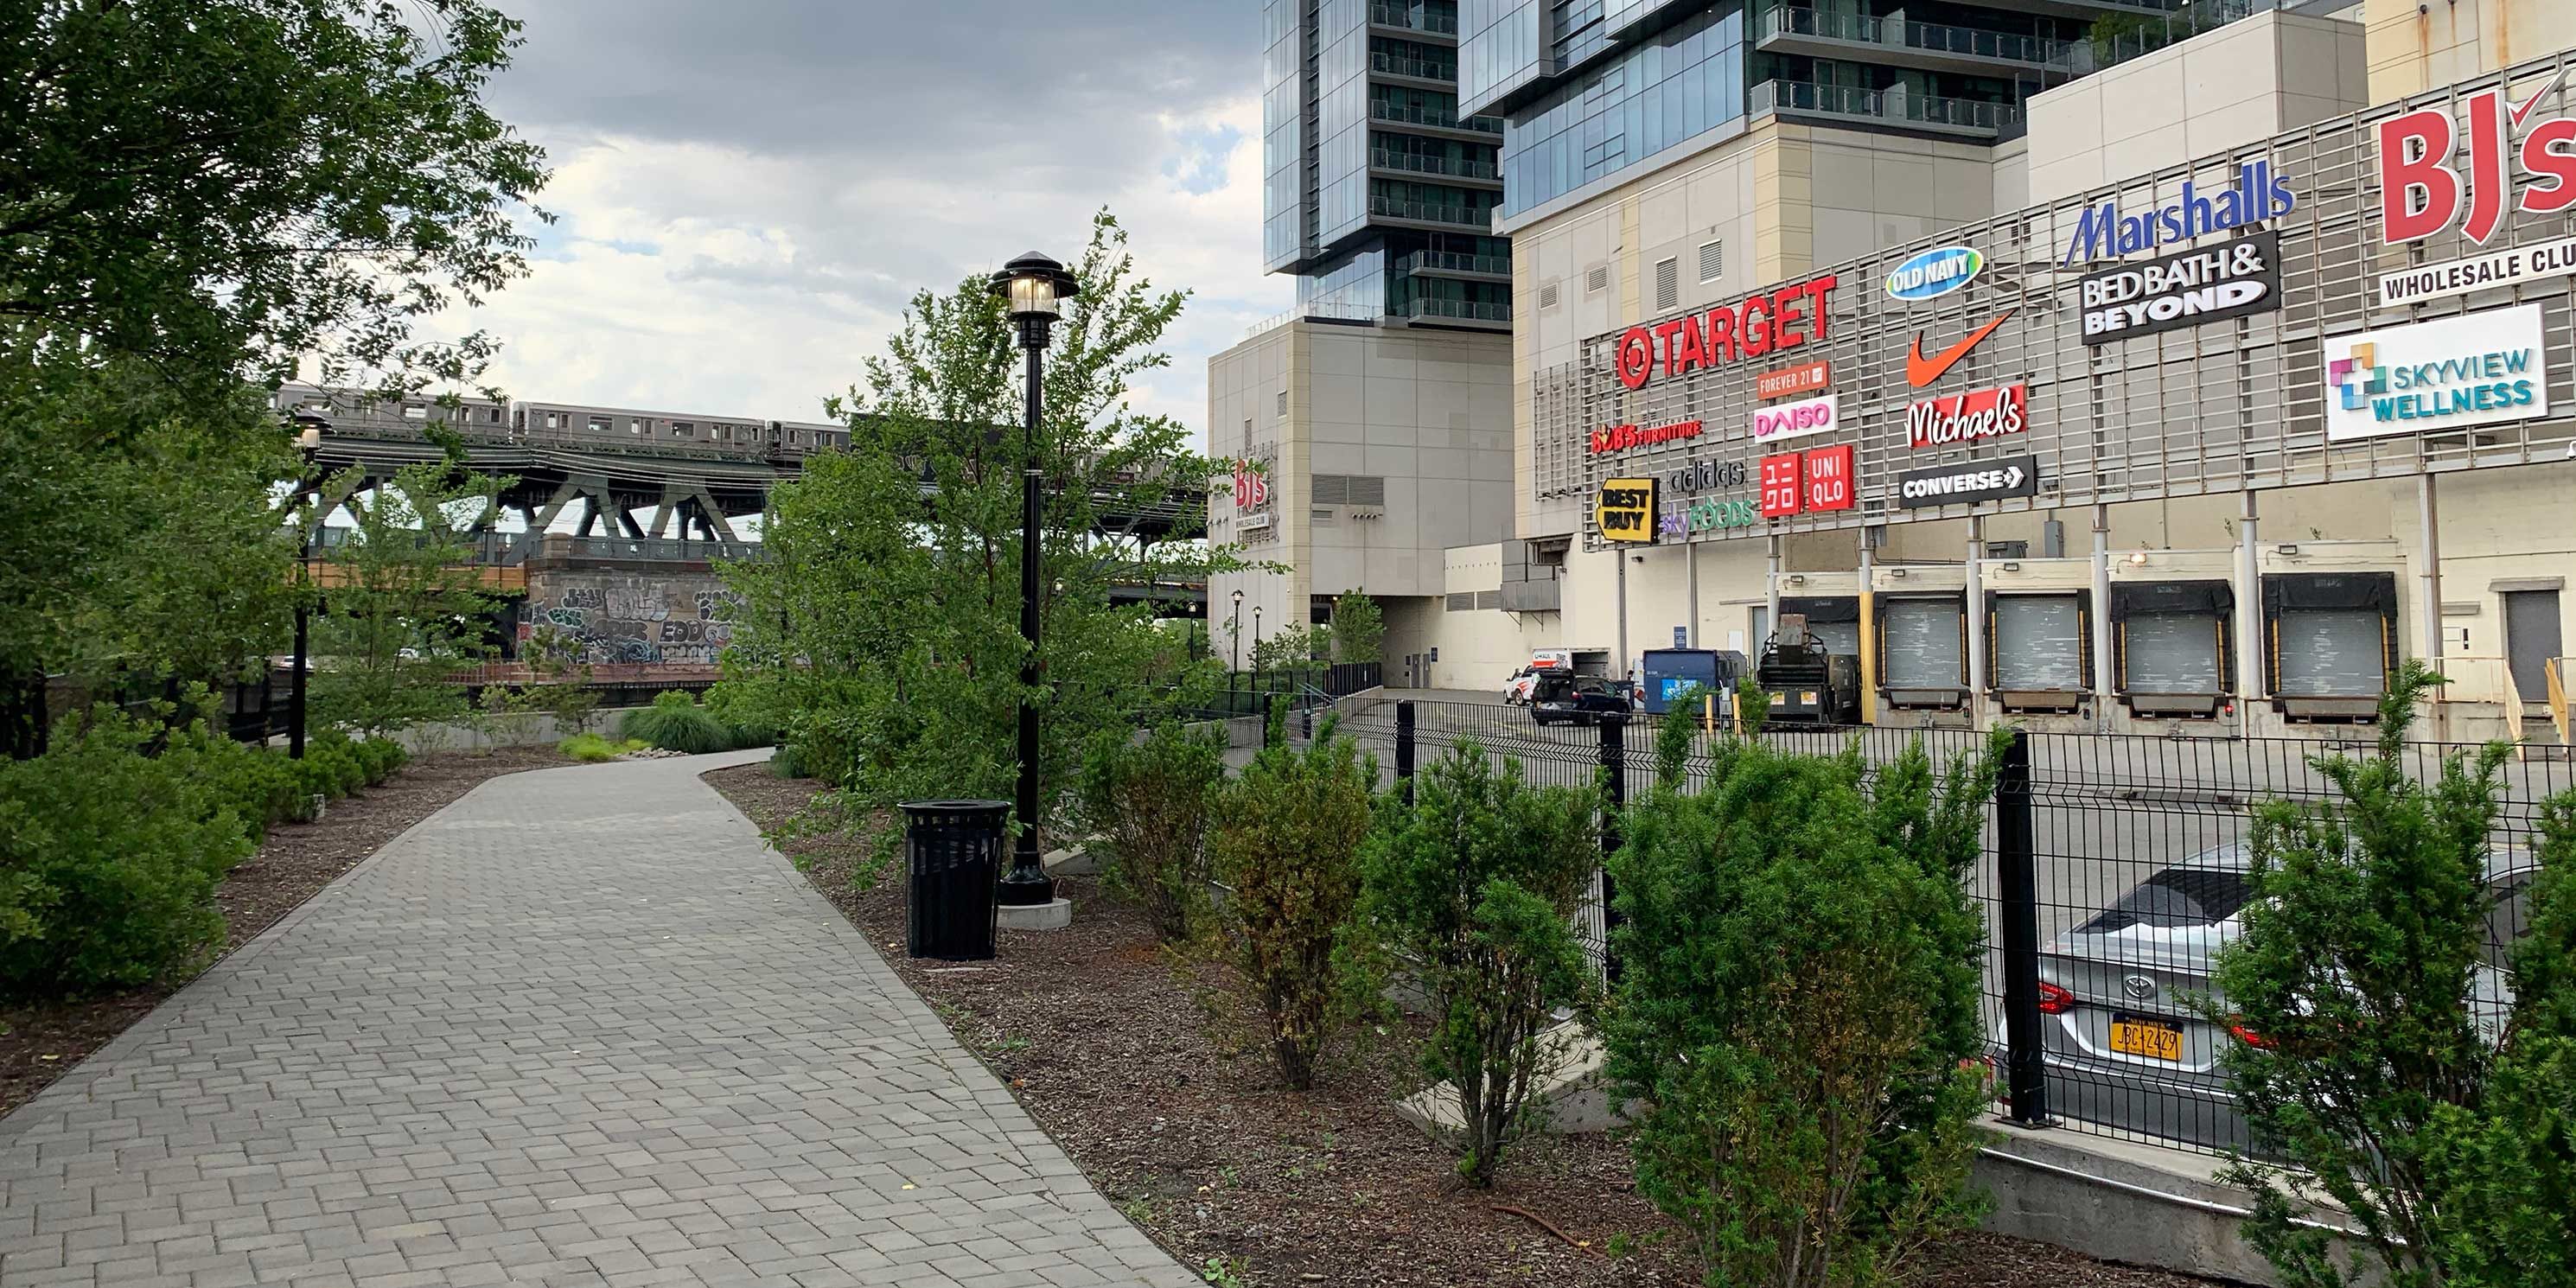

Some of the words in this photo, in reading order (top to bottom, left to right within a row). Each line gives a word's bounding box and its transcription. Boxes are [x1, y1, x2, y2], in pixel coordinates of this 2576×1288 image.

[2063, 159, 2297, 268] Marshalls
[1893, 267, 1924, 292] OLD
[1925, 253, 1969, 284] NAVY
[2083, 271, 2145, 309] BED
[2385, 255, 2521, 300] WHOLESALE
[2531, 243, 2576, 272] CLU
[2084, 280, 2267, 335] BEYOND
[1655, 276, 1838, 378] TARGET
[1760, 373, 1797, 394] FOREVER
[1801, 369, 1809, 386] 21
[2394, 348, 2533, 390] SKYVIEW
[1904, 387, 2021, 448] Michaels
[2371, 379, 2535, 422] WELLNESS
[1637, 420, 1704, 445] FURNITURE
[1756, 403, 1830, 437] DAISO
[1668, 458, 1745, 494] adidas
[1812, 456, 1840, 479] UNI
[1903, 469, 2004, 499] CONVERSE
[1602, 488, 1649, 508] BEST
[1813, 480, 1843, 507] QLO
[1604, 511, 1645, 531] BUY
